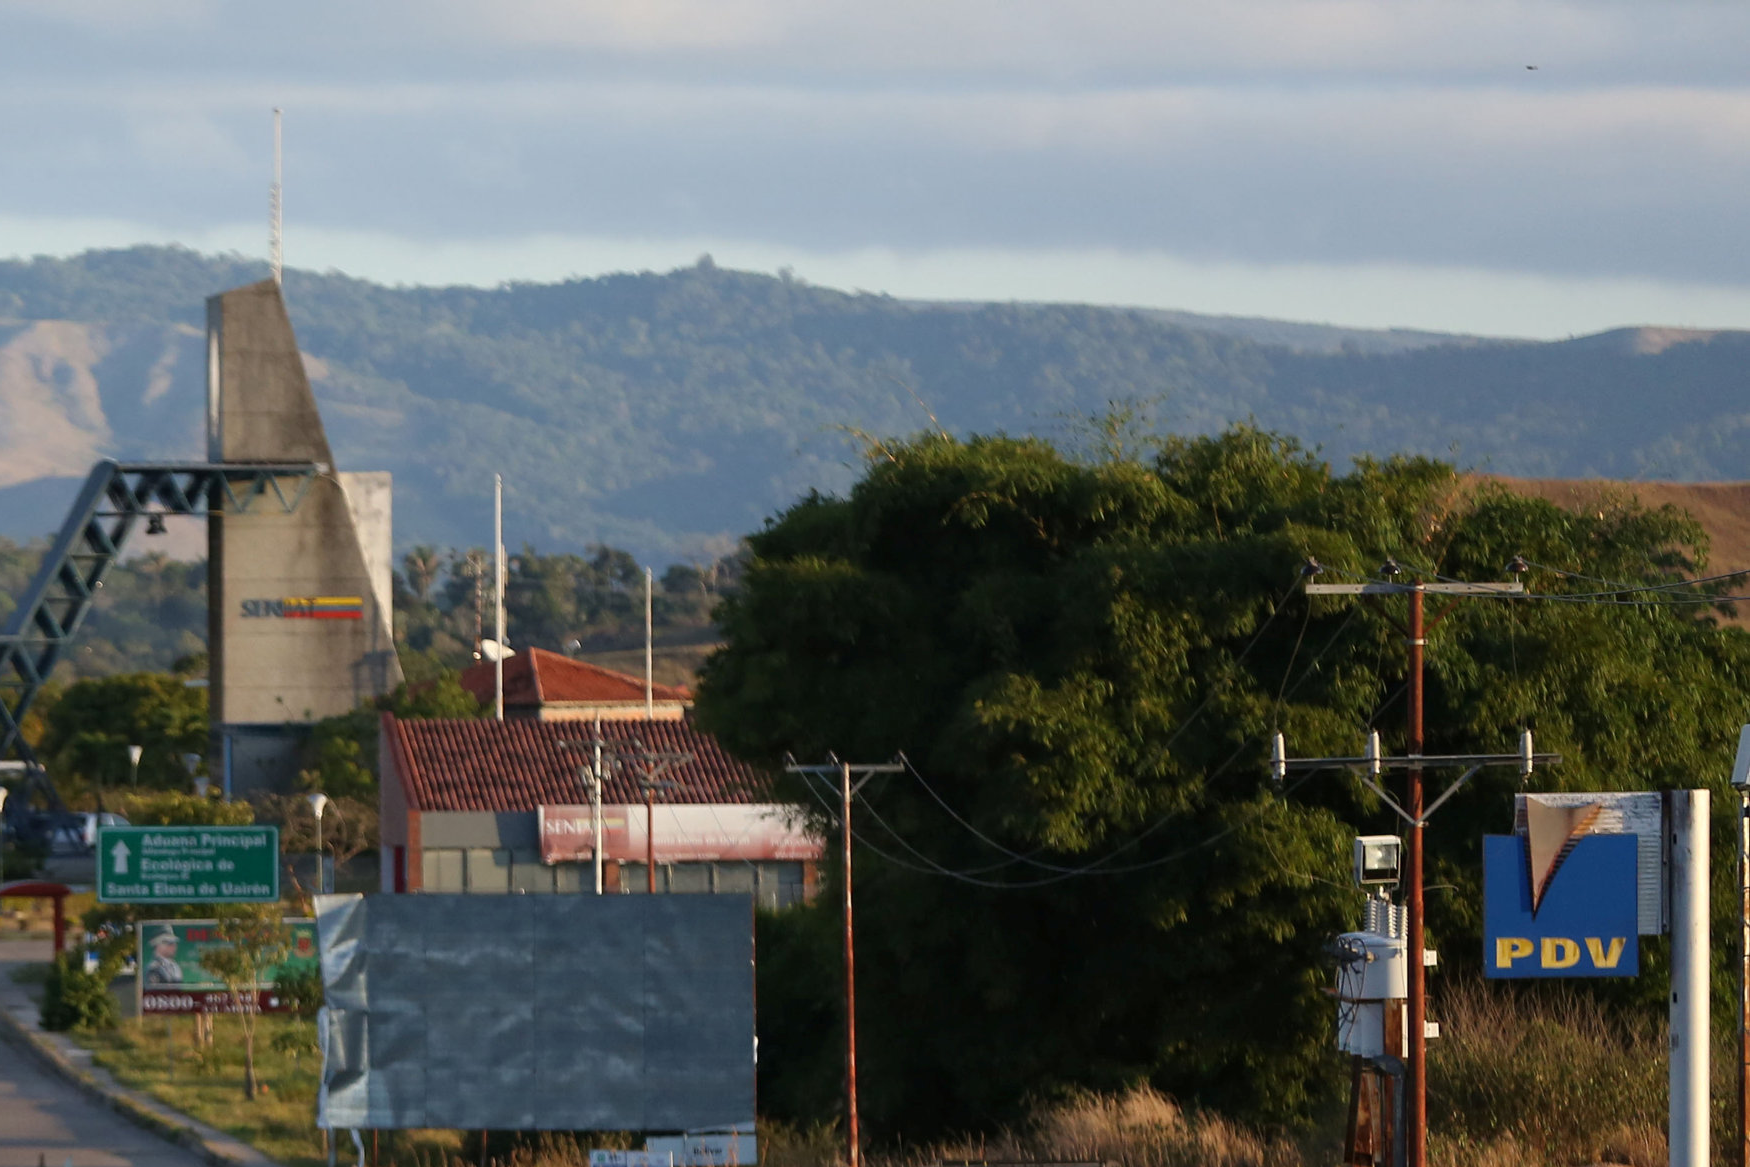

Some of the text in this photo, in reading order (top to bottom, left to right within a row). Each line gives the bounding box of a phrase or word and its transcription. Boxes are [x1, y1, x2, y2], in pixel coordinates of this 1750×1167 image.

[142, 833, 267, 849] Aduana Principal
[218, 859, 235, 871] de
[107, 882, 149, 895] Santa
[153, 882, 195, 895] Elena
[200, 882, 217, 895] de
[1496, 937, 1627, 969] PDV
